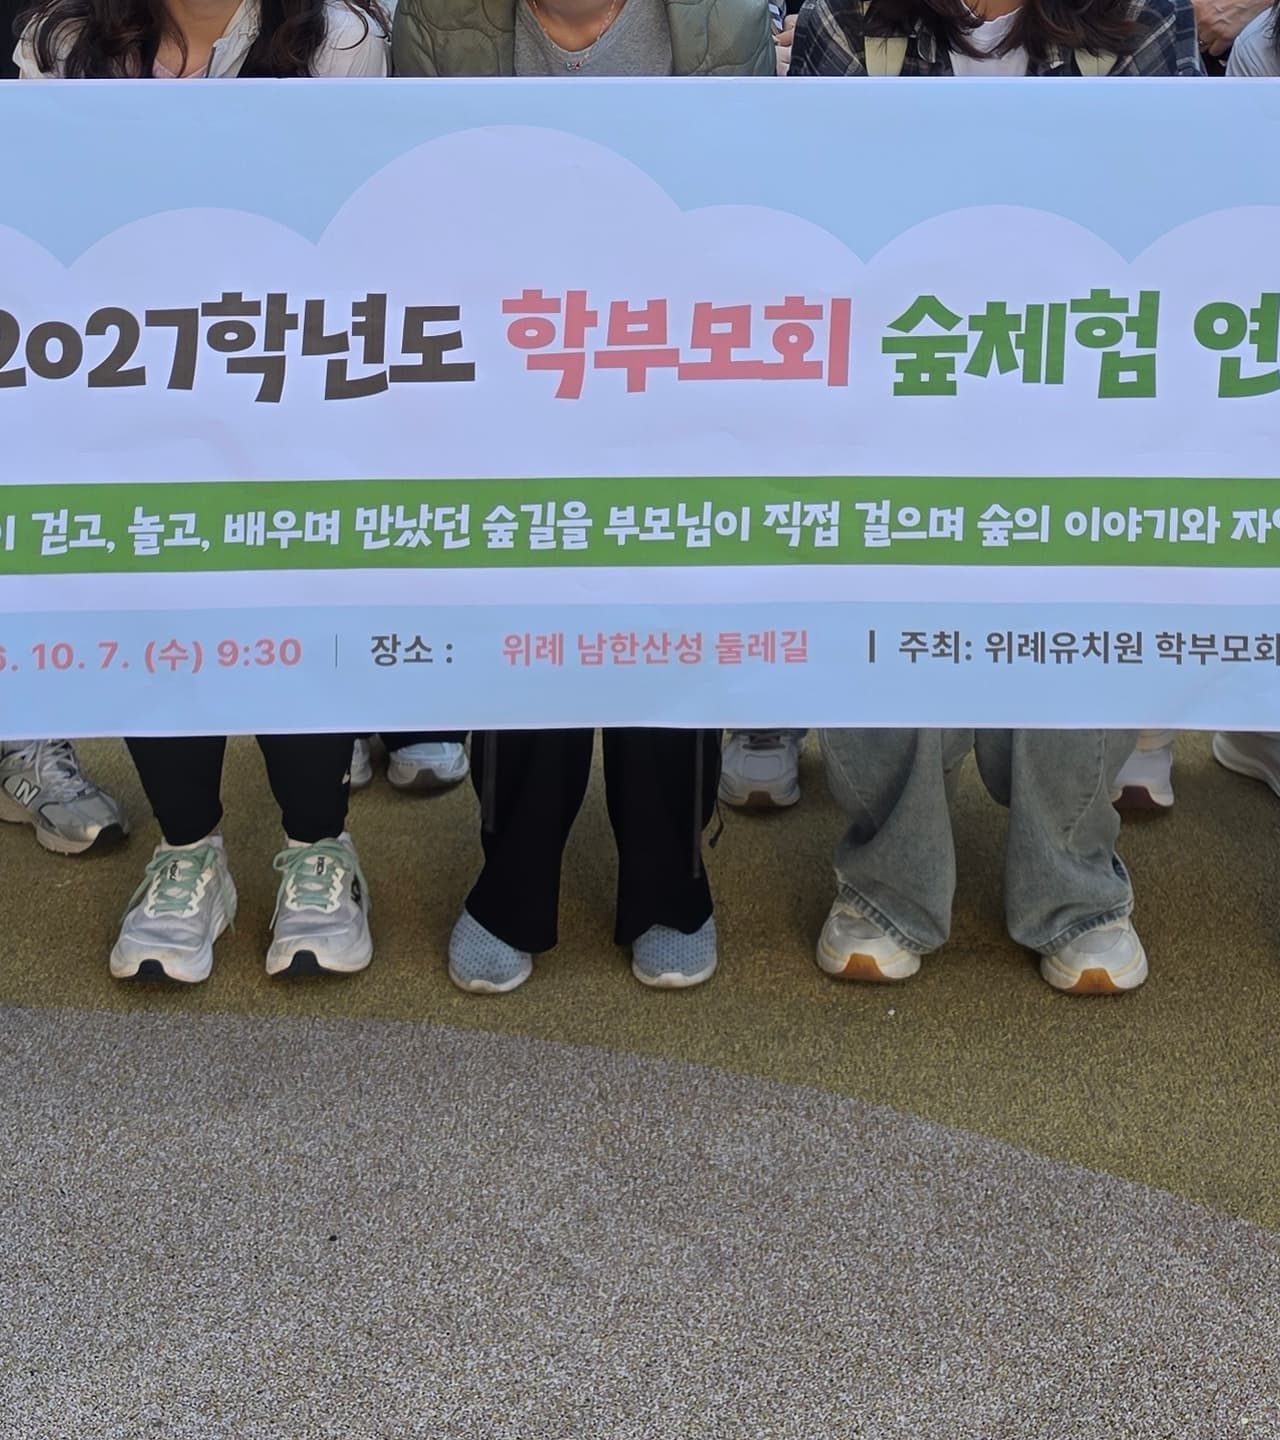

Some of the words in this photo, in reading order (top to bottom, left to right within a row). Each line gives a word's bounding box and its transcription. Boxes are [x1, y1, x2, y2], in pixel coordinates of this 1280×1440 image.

[502, 289, 851, 399] 학부모회
[882, 289, 1160, 399] 숲체험
[32, 509, 115, 555] 걷고,
[128, 507, 209, 555] 놀고,
[224, 510, 340, 548] 배우며
[355, 504, 470, 549] 만났던
[483, 501, 592, 549] 숲길을
[604, 501, 750, 547] 부모님이
[763, 501, 839, 547] 직접
[855, 500, 964, 547] 걸으며
[977, 504, 1050, 546] 숲의
[1065, 506, 1220, 544] 이야기와
[32, 643, 84, 670] 10.
[99, 641, 129, 668] 7.
[145, 639, 202, 673] (수)
[217, 638, 301, 667] 9:30
[371, 634, 433, 666] 장소
[503, 633, 563, 666] 위례
[578, 632, 702, 665] 남한산성
[715, 630, 807, 665] 둘레길
[899, 631, 971, 664] 주최:
[985, 631, 1142, 664] 위례유치원
[1156, 632, 1280, 666] 학부모회
